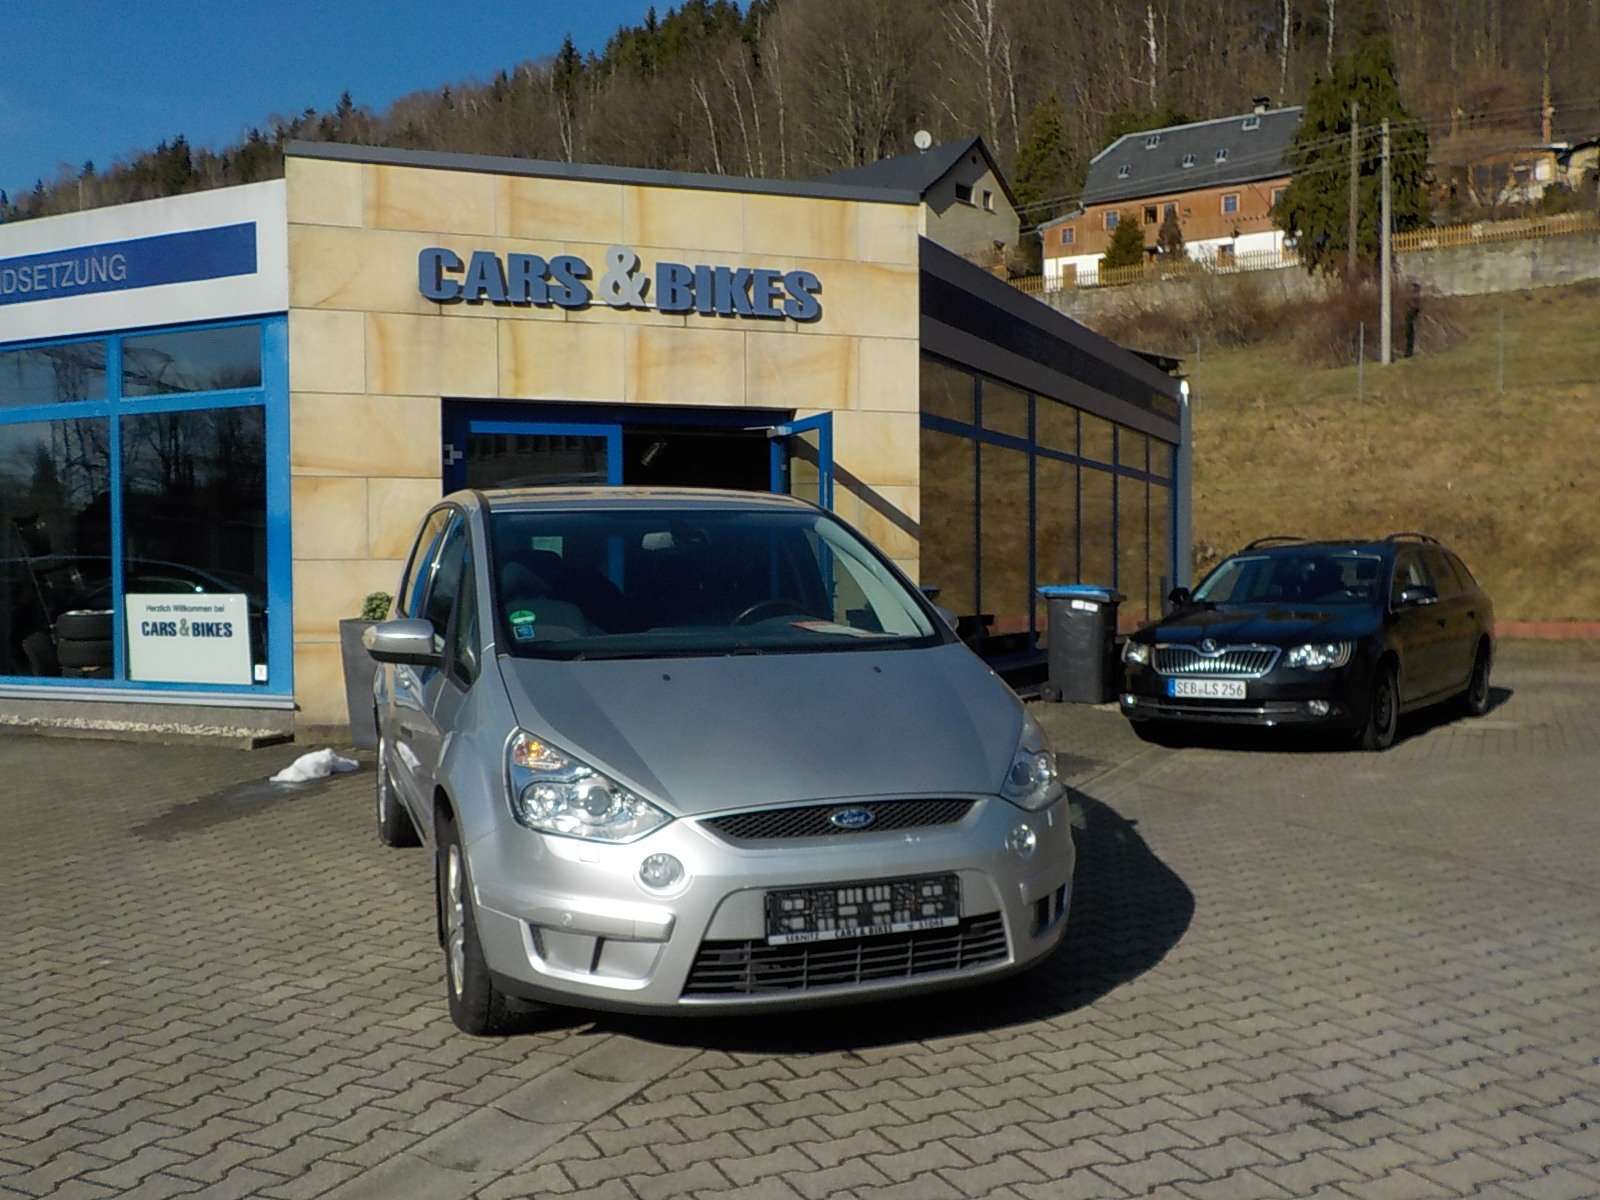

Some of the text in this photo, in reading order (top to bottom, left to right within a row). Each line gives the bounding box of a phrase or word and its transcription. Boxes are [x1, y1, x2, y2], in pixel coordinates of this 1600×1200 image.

[0, 254, 127, 295] DSETZUNG
[417, 245, 820, 319] CARS & BIKES
[141, 618, 233, 638] CARS & BIKES
[1221, 682, 1244, 697] 256
